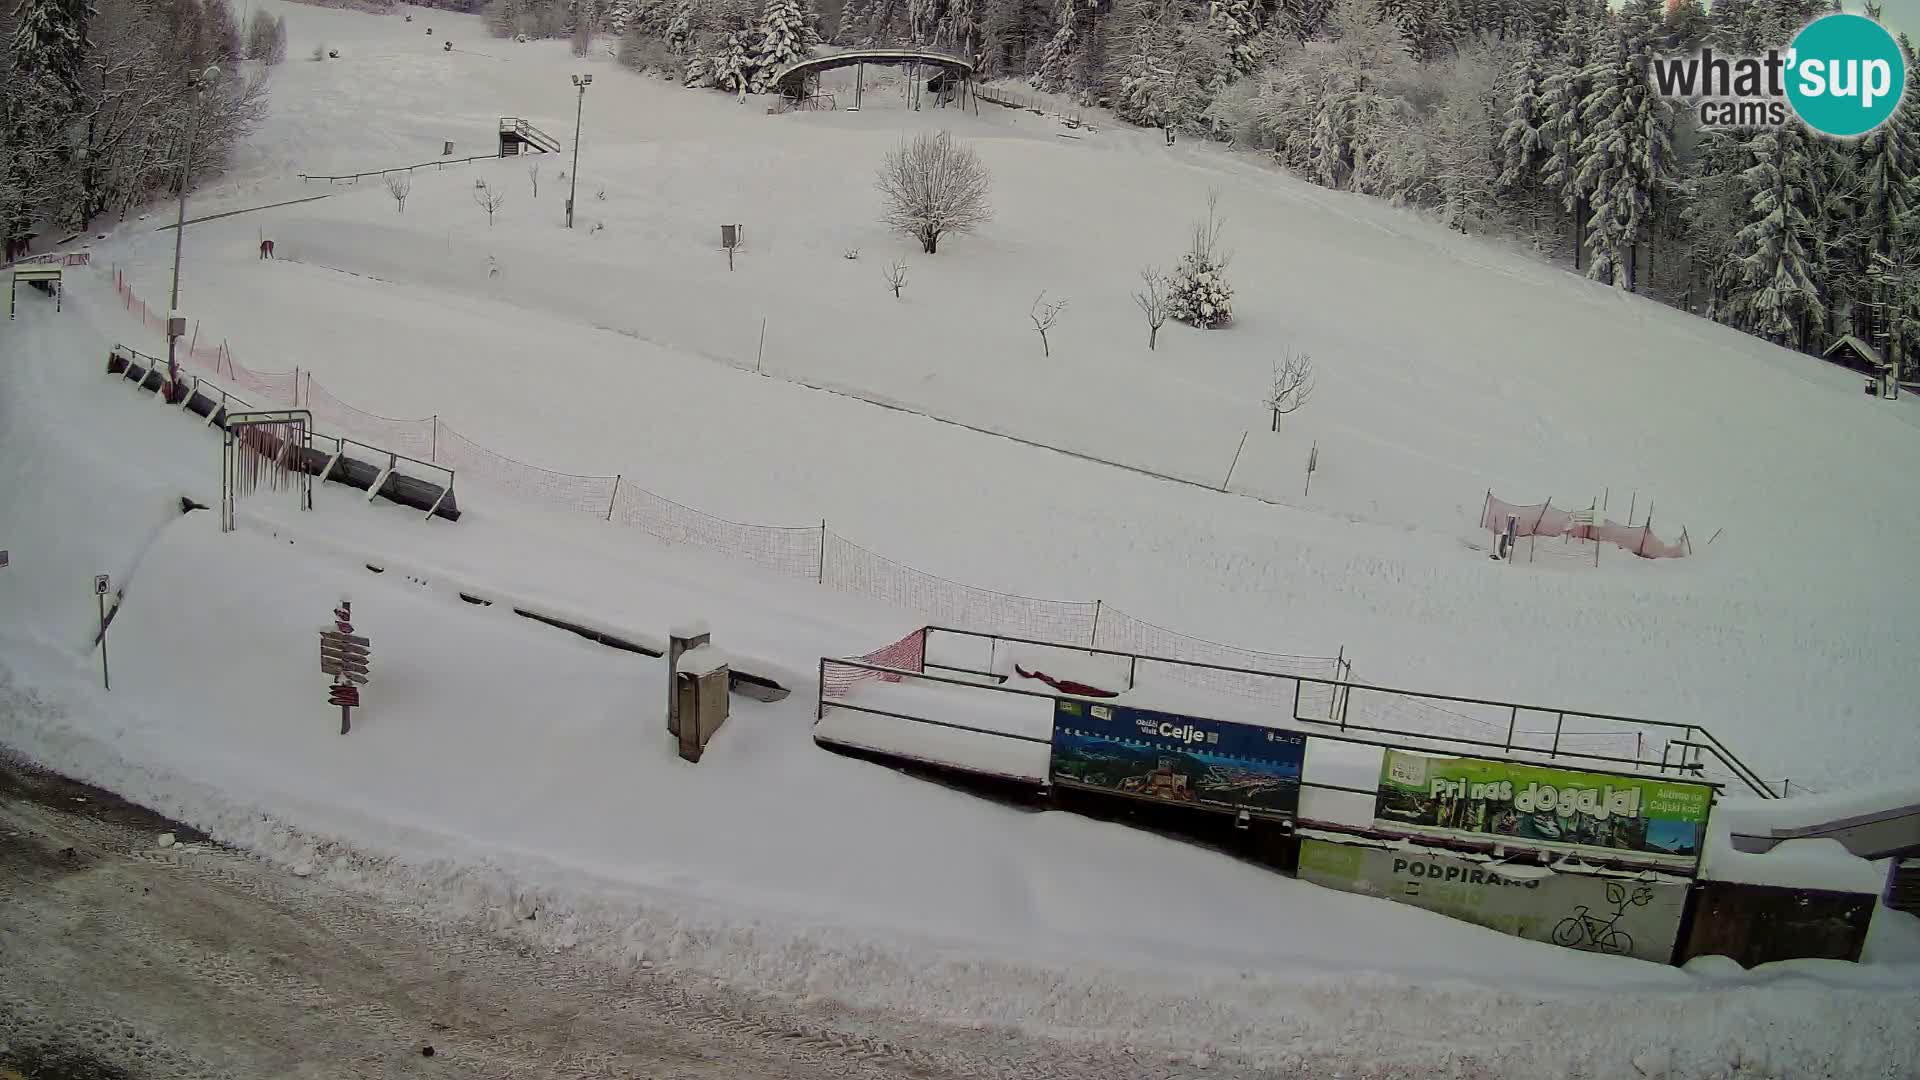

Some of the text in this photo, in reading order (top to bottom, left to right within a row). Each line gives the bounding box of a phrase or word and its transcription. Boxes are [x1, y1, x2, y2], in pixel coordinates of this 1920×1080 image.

[1141, 727, 1158, 735] Visit
[1159, 722, 1205, 744] Celje
[1430, 776, 1513, 802] Pri nas
[1514, 782, 1641, 820] dogaja!
